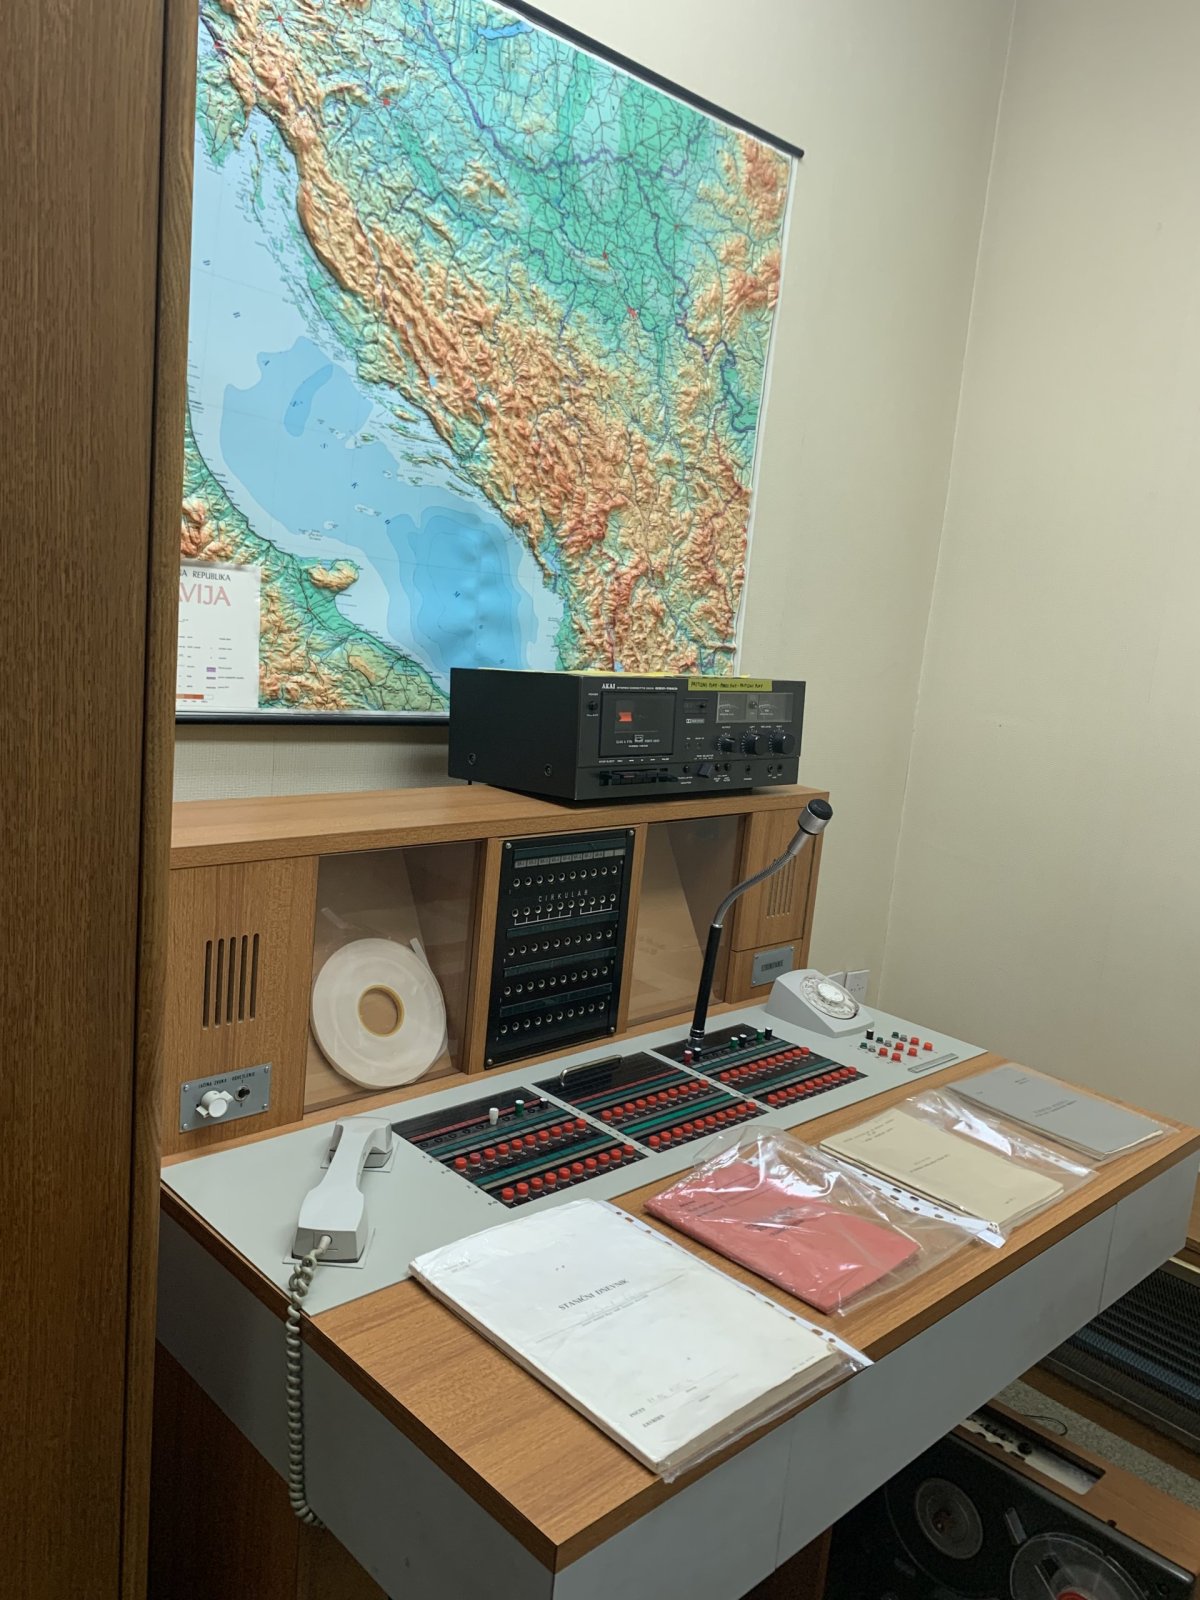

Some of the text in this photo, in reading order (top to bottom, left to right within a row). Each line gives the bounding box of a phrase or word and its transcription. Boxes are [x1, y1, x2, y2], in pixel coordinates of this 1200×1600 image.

[192, 570, 231, 582] REPUBLIKA
[179, 581, 232, 607] VIJA
[601, 682, 616, 690] AKAI
[538, 889, 588, 903] CIRKULAR
